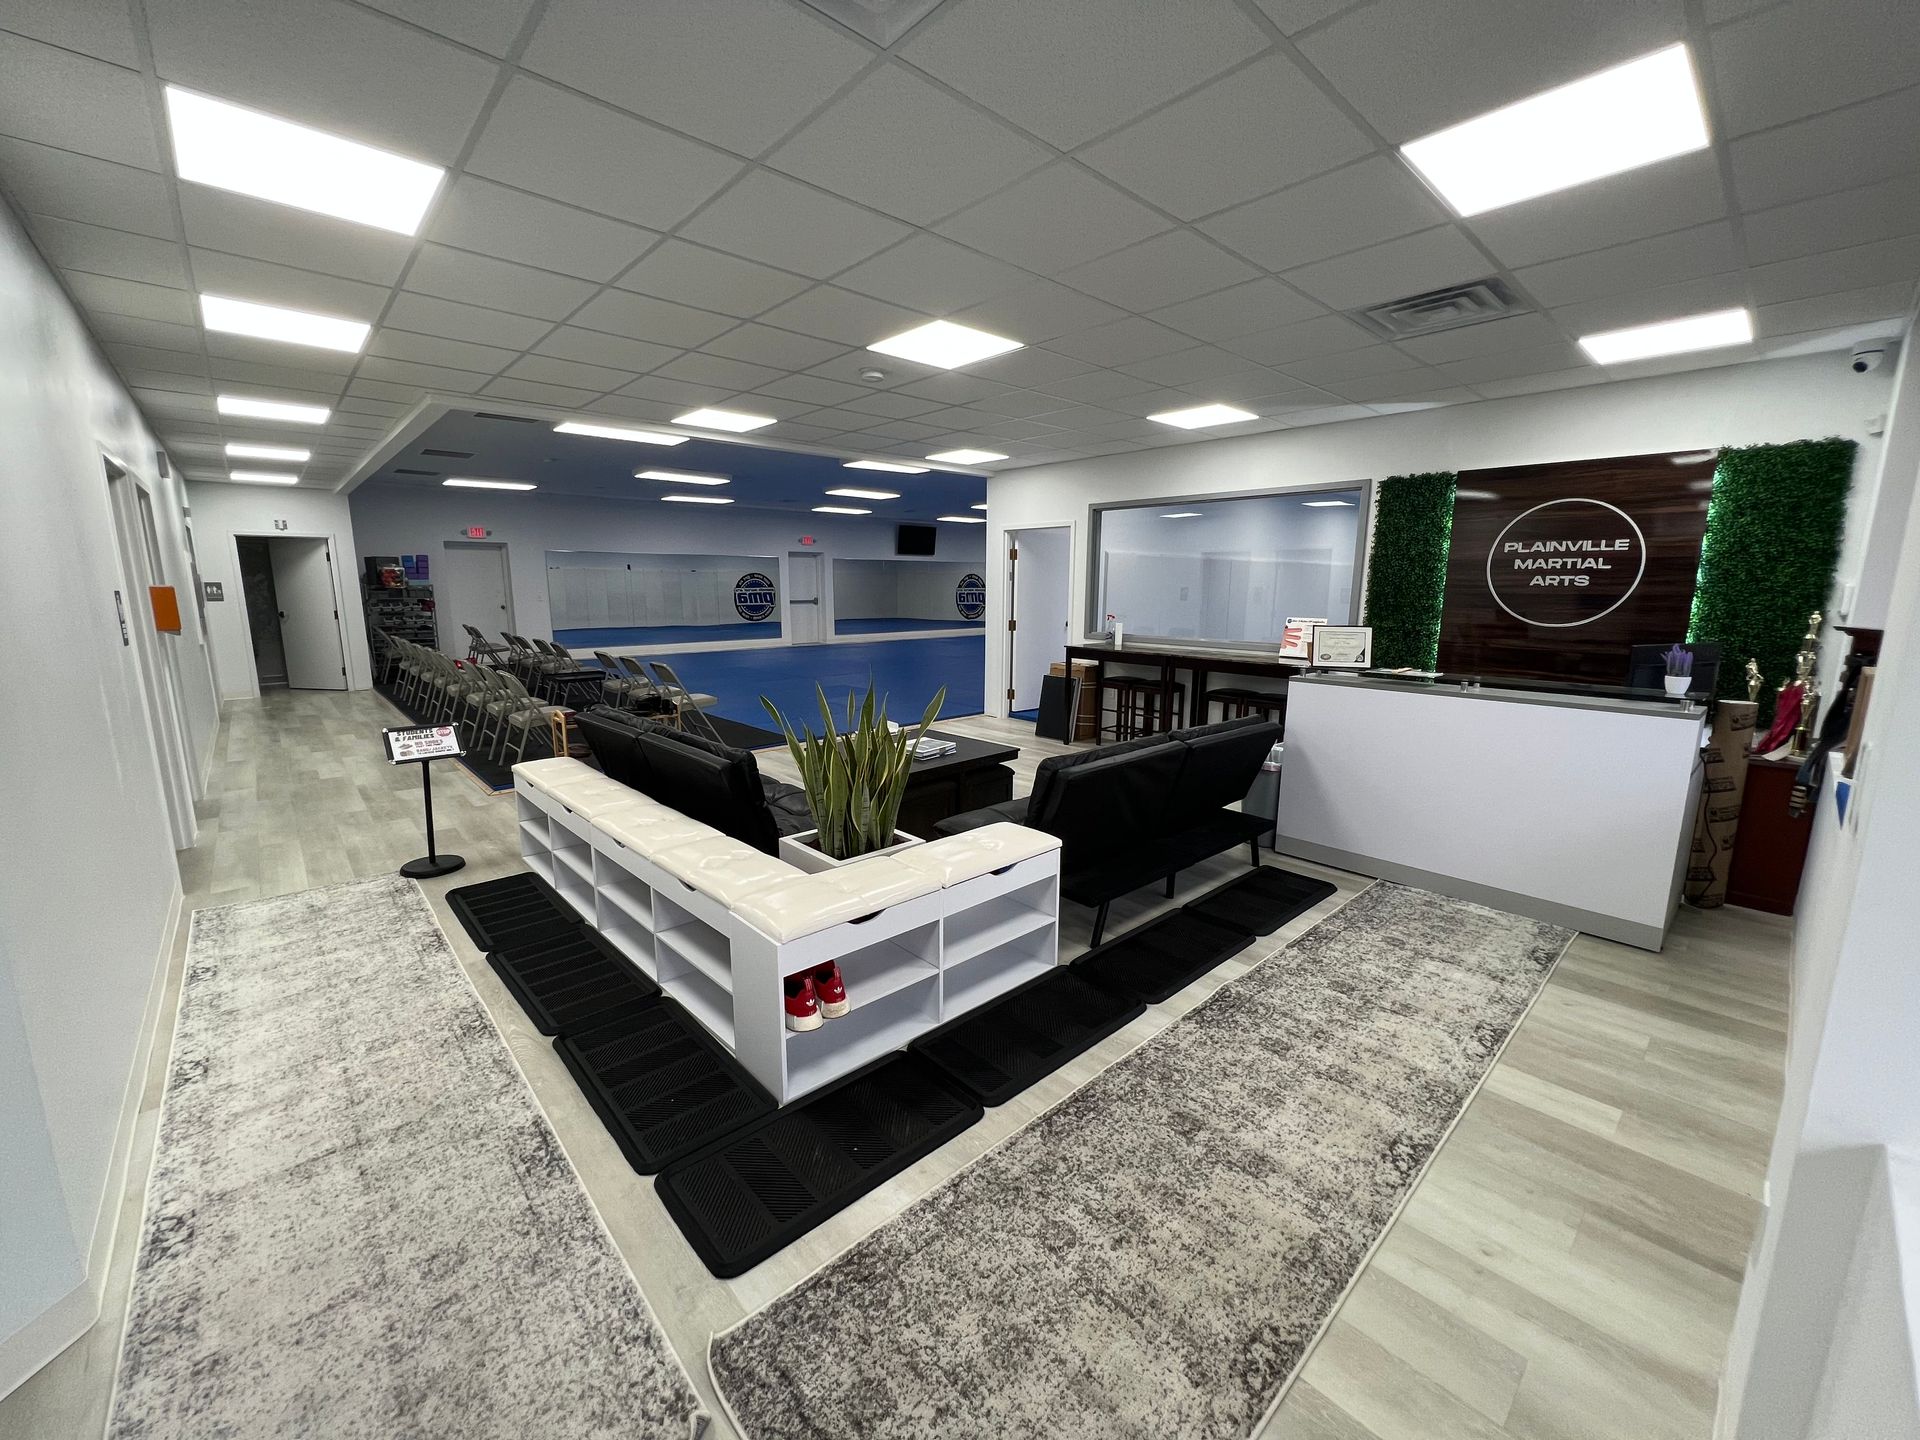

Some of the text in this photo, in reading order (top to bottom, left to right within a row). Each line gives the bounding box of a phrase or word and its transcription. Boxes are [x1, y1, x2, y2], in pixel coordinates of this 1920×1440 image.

[1503, 539, 1630, 553] PLAINVILLE
[1514, 557, 1612, 570] MARTIAL
[1529, 575, 1590, 587] ARTS
[402, 733, 435, 742] FAMILIES
